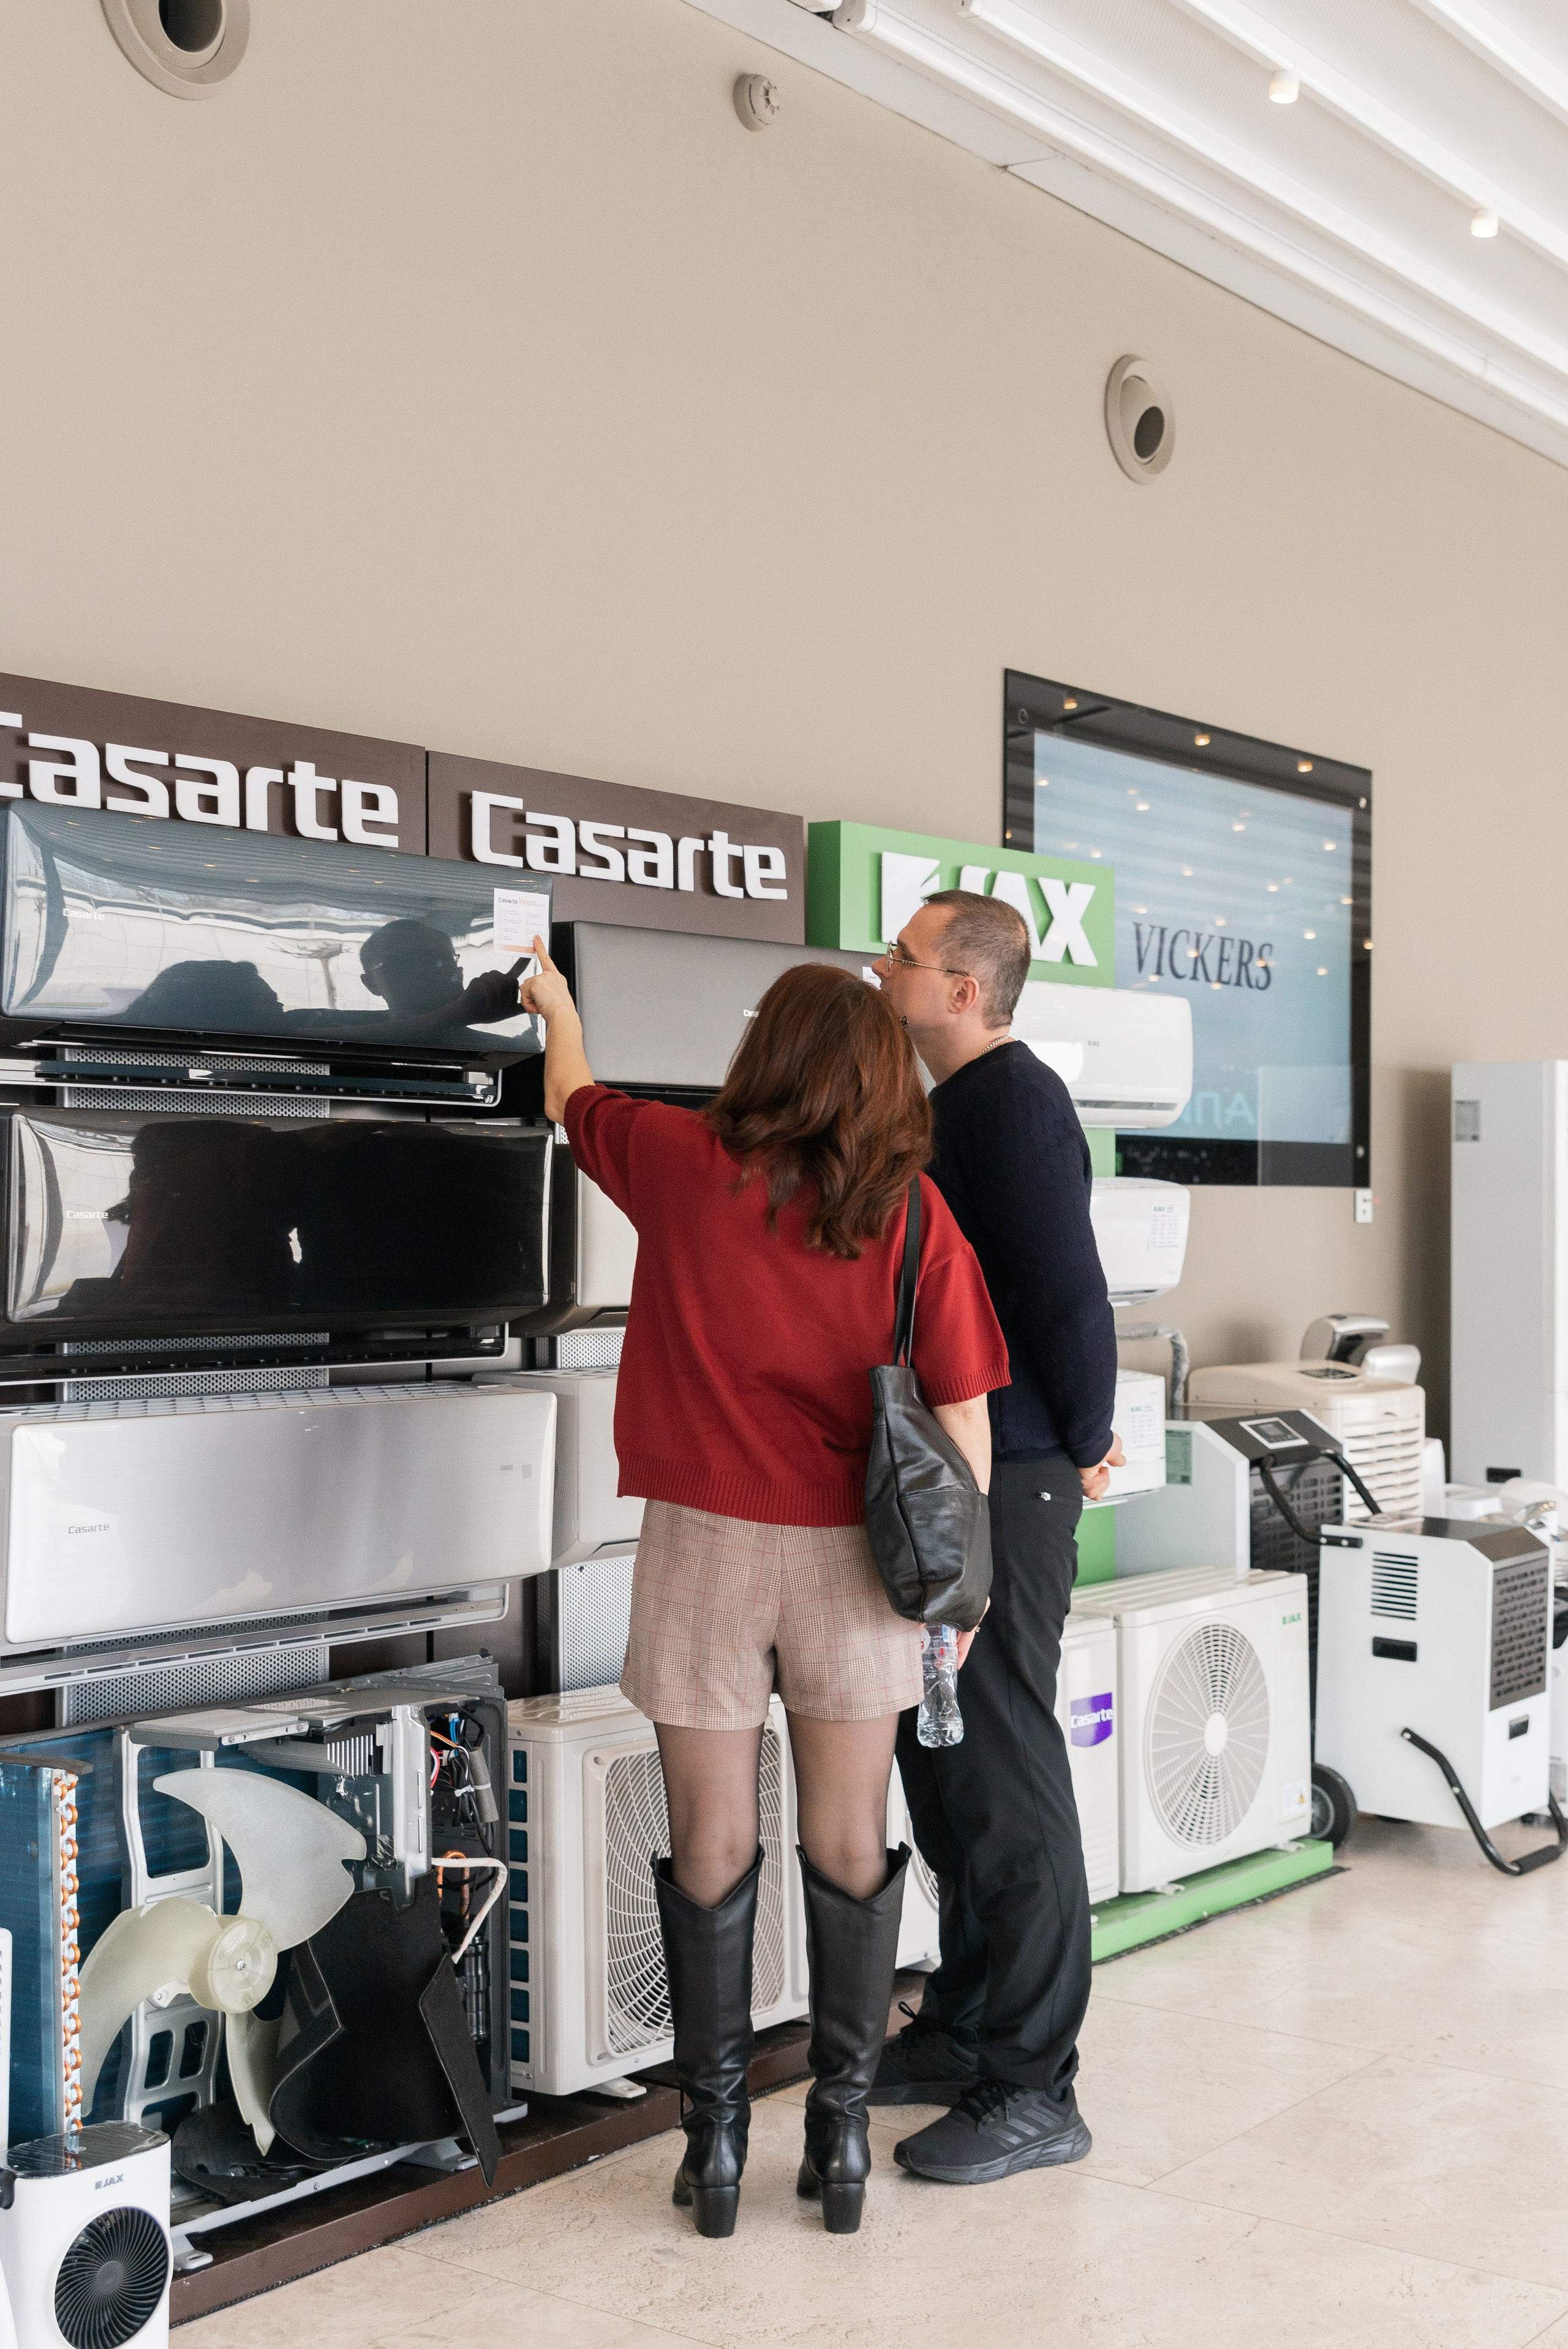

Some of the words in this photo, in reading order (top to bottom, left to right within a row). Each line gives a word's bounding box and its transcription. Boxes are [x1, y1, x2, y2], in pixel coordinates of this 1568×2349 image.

[472, 790, 788, 900] Casarte
[62, 908, 105, 921] Casarte
[1133, 921, 1273, 991] VICKERS
[66, 1210, 108, 1219] Casarte
[68, 1524, 110, 1534] Casarte
[1070, 1708, 1113, 1729] Casarte
